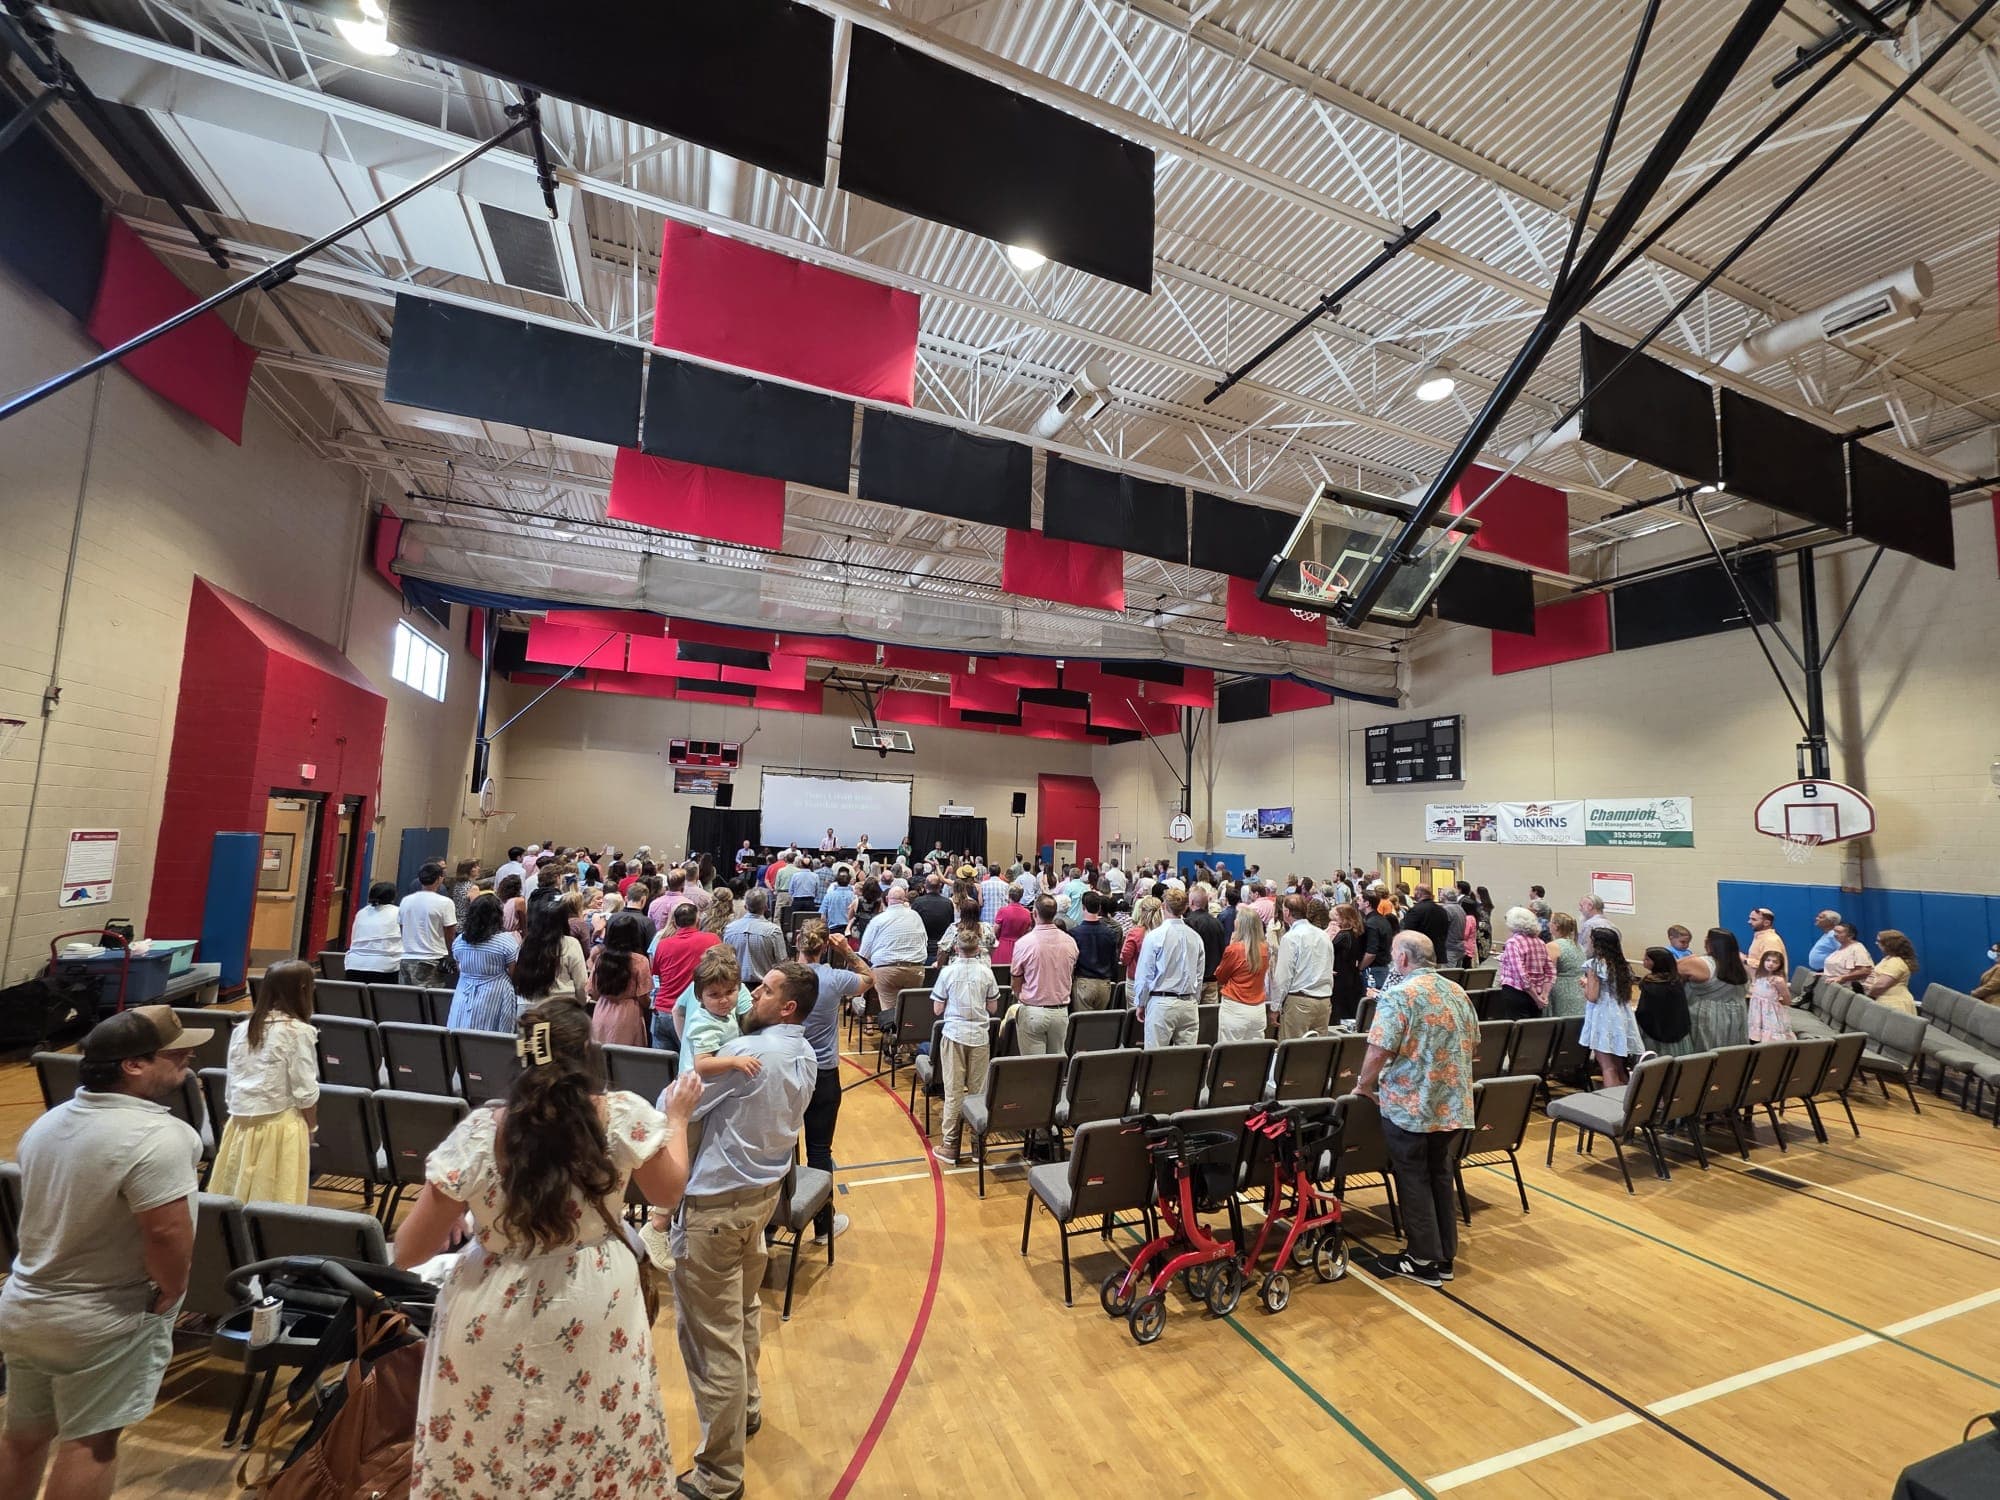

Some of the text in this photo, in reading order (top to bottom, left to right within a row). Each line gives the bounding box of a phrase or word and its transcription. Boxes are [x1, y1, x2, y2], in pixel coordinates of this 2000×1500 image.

[1433, 719, 1454, 728] HOME
[1368, 728, 1388, 736] GUEST
[1803, 784, 1818, 798] B
[1590, 808, 1657, 822] Champion
[1513, 817, 1568, 828] DINKINS
